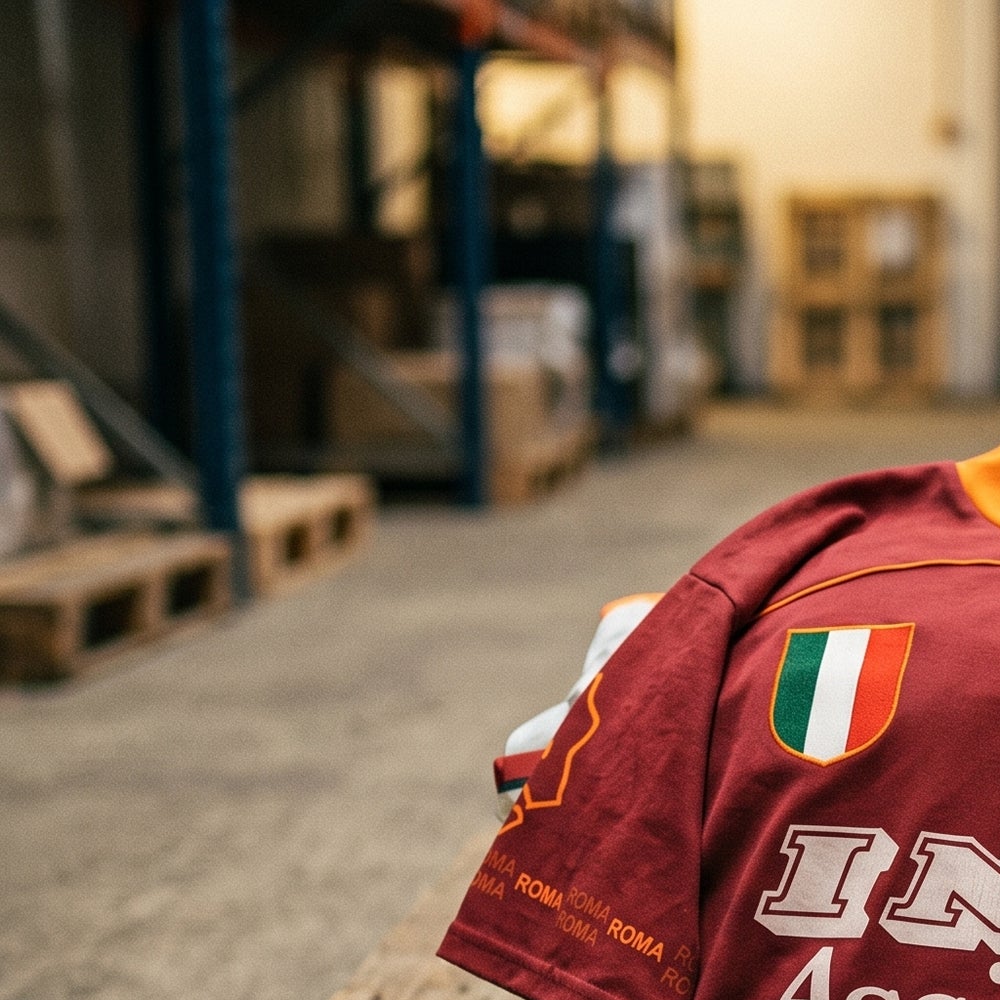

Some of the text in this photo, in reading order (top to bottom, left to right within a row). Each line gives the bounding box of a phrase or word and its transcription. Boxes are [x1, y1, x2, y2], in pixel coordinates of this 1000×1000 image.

[484, 850, 517, 877] MA
[514, 872, 564, 911] ROMA
[567, 886, 611, 924] ROMA
[556, 910, 600, 947] ROMA
[606, 918, 665, 962] ROMA
